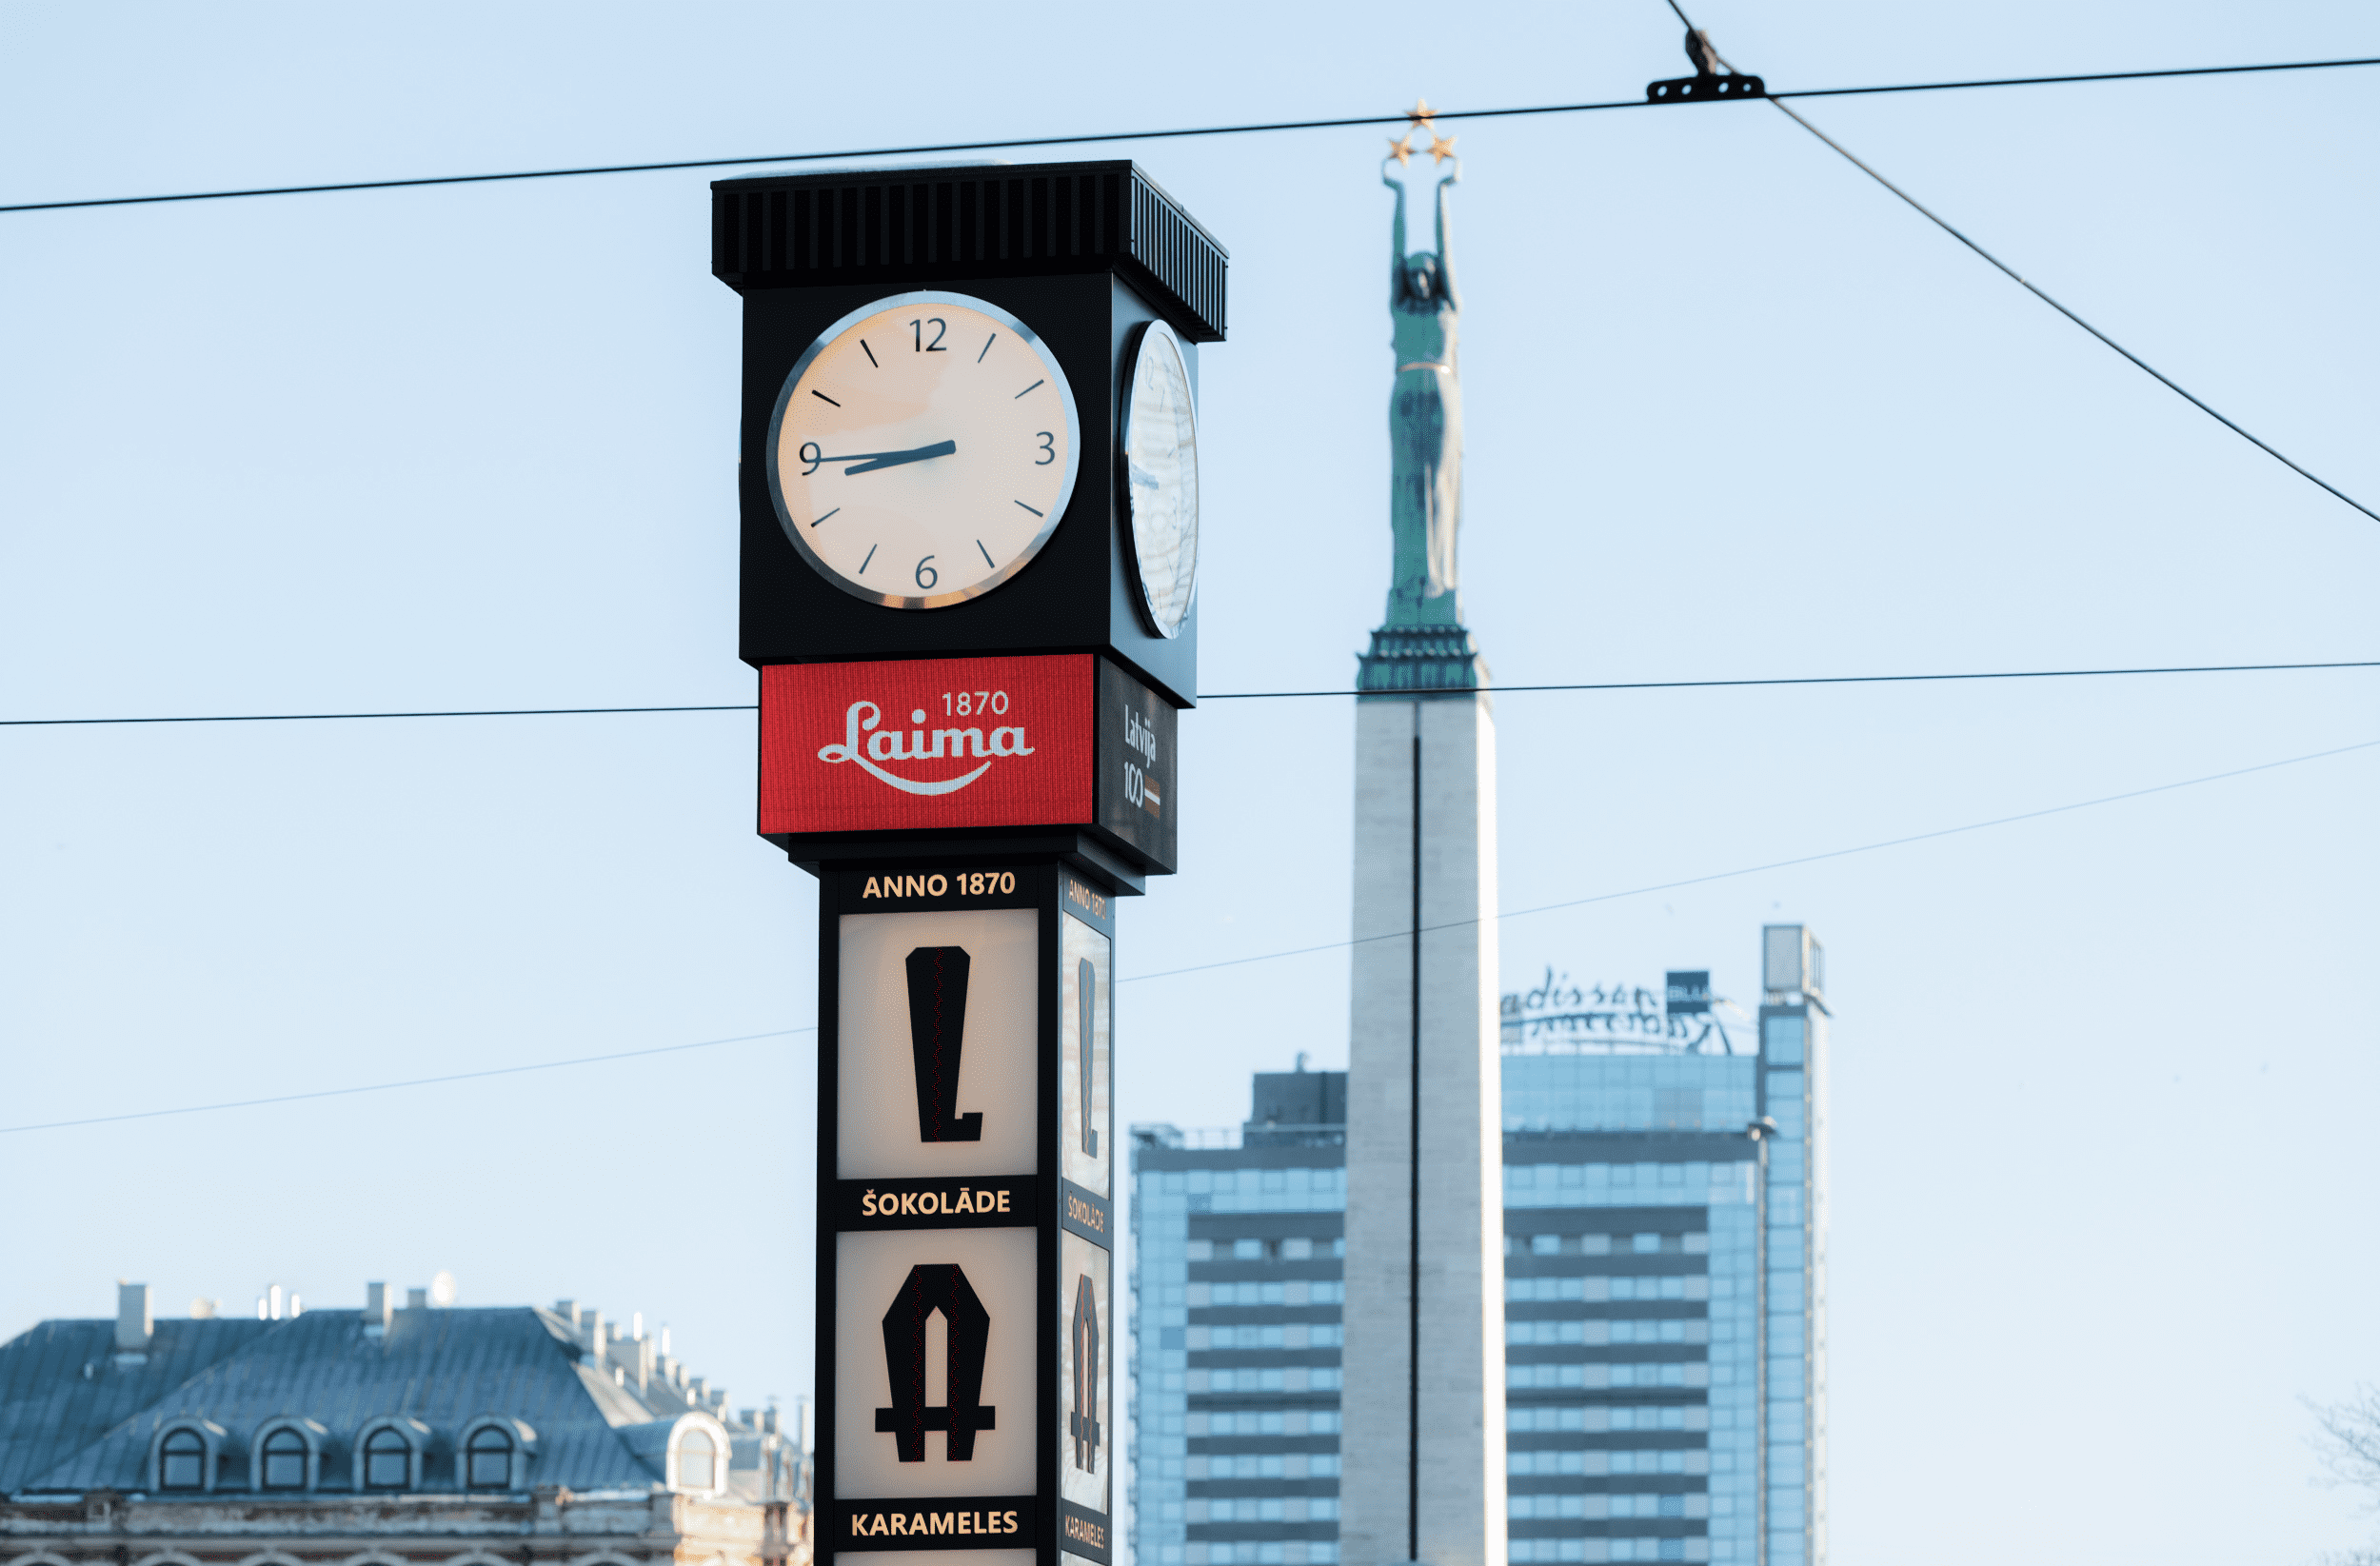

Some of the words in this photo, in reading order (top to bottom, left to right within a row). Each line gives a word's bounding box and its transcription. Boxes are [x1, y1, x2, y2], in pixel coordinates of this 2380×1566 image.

[910, 318, 947, 353] 12
[800, 442, 822, 477] 9
[1036, 431, 1056, 466] 3
[915, 555, 938, 589] 6
[942, 691, 1009, 716] 1870
[818, 701, 1036, 796] Laima
[1124, 704, 1157, 768] Latvija
[863, 875, 948, 899] ANNO
[956, 872, 1016, 895] 1870
[1068, 879, 1091, 911] ANNO
[1091, 893, 1107, 920] 1870
[1499, 964, 1660, 1016] adisson
[863, 1188, 1011, 1217] ŠOKOLĀDE
[852, 1511, 1019, 1536] KARAMELES
[1065, 1514, 1105, 1550] KARAMELES
